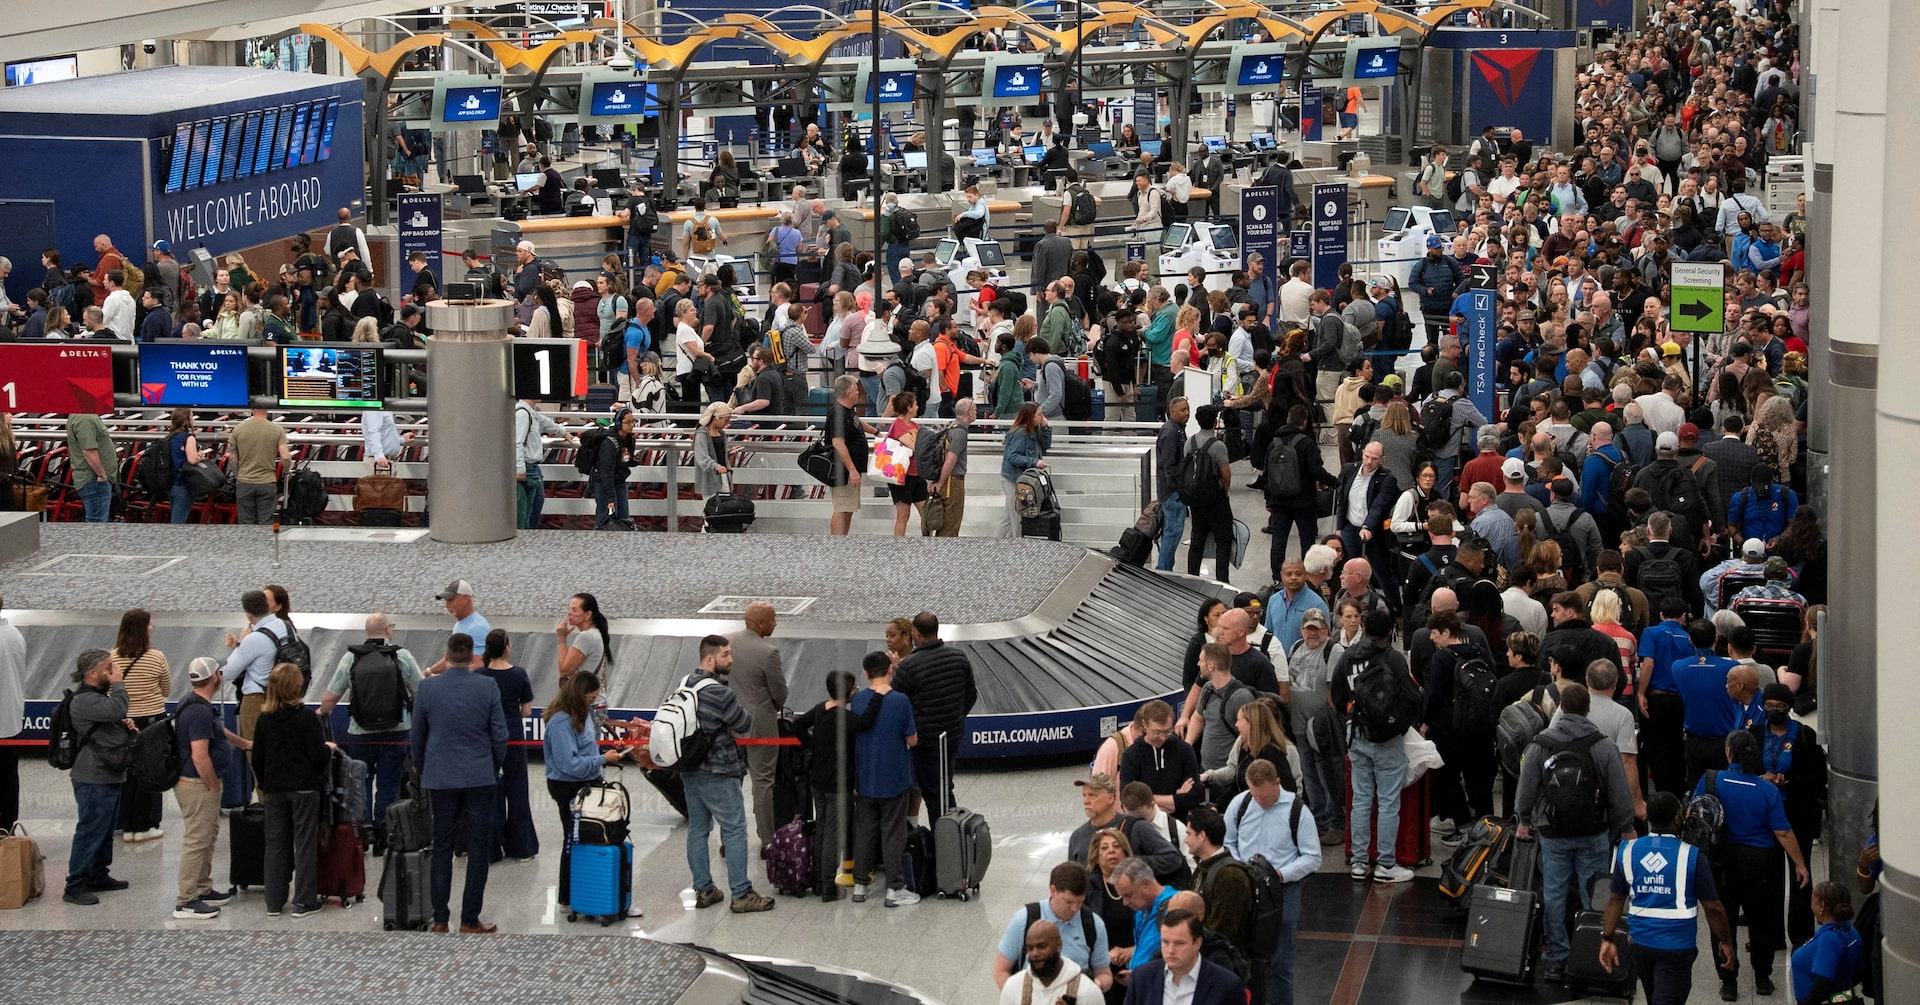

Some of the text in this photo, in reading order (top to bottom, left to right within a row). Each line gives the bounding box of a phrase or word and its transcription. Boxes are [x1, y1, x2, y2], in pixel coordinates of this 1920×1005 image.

[515, 3, 545, 11] Ticeting
[1500, 34, 1508, 44] 3
[167, 176, 321, 244] WELCOME ABOARD
[1257, 208, 1262, 217] 1
[1327, 204, 1333, 214] 2
[1674, 266, 1720, 277] General Security
[1683, 276, 1712, 286] Screening
[267, 332, 274, 340] 2
[1476, 316, 1486, 395] TSA PreCheck
[169, 361, 218, 370] THANK YOU
[533, 349, 551, 395] 1
[1, 381, 17, 409] 1
[22, 716, 51, 730] A.CO
[972, 725, 1074, 744] DELTA.COM/AMEX
[1643, 874, 1665, 885] unifi
[1636, 885, 1672, 895] LEADER
